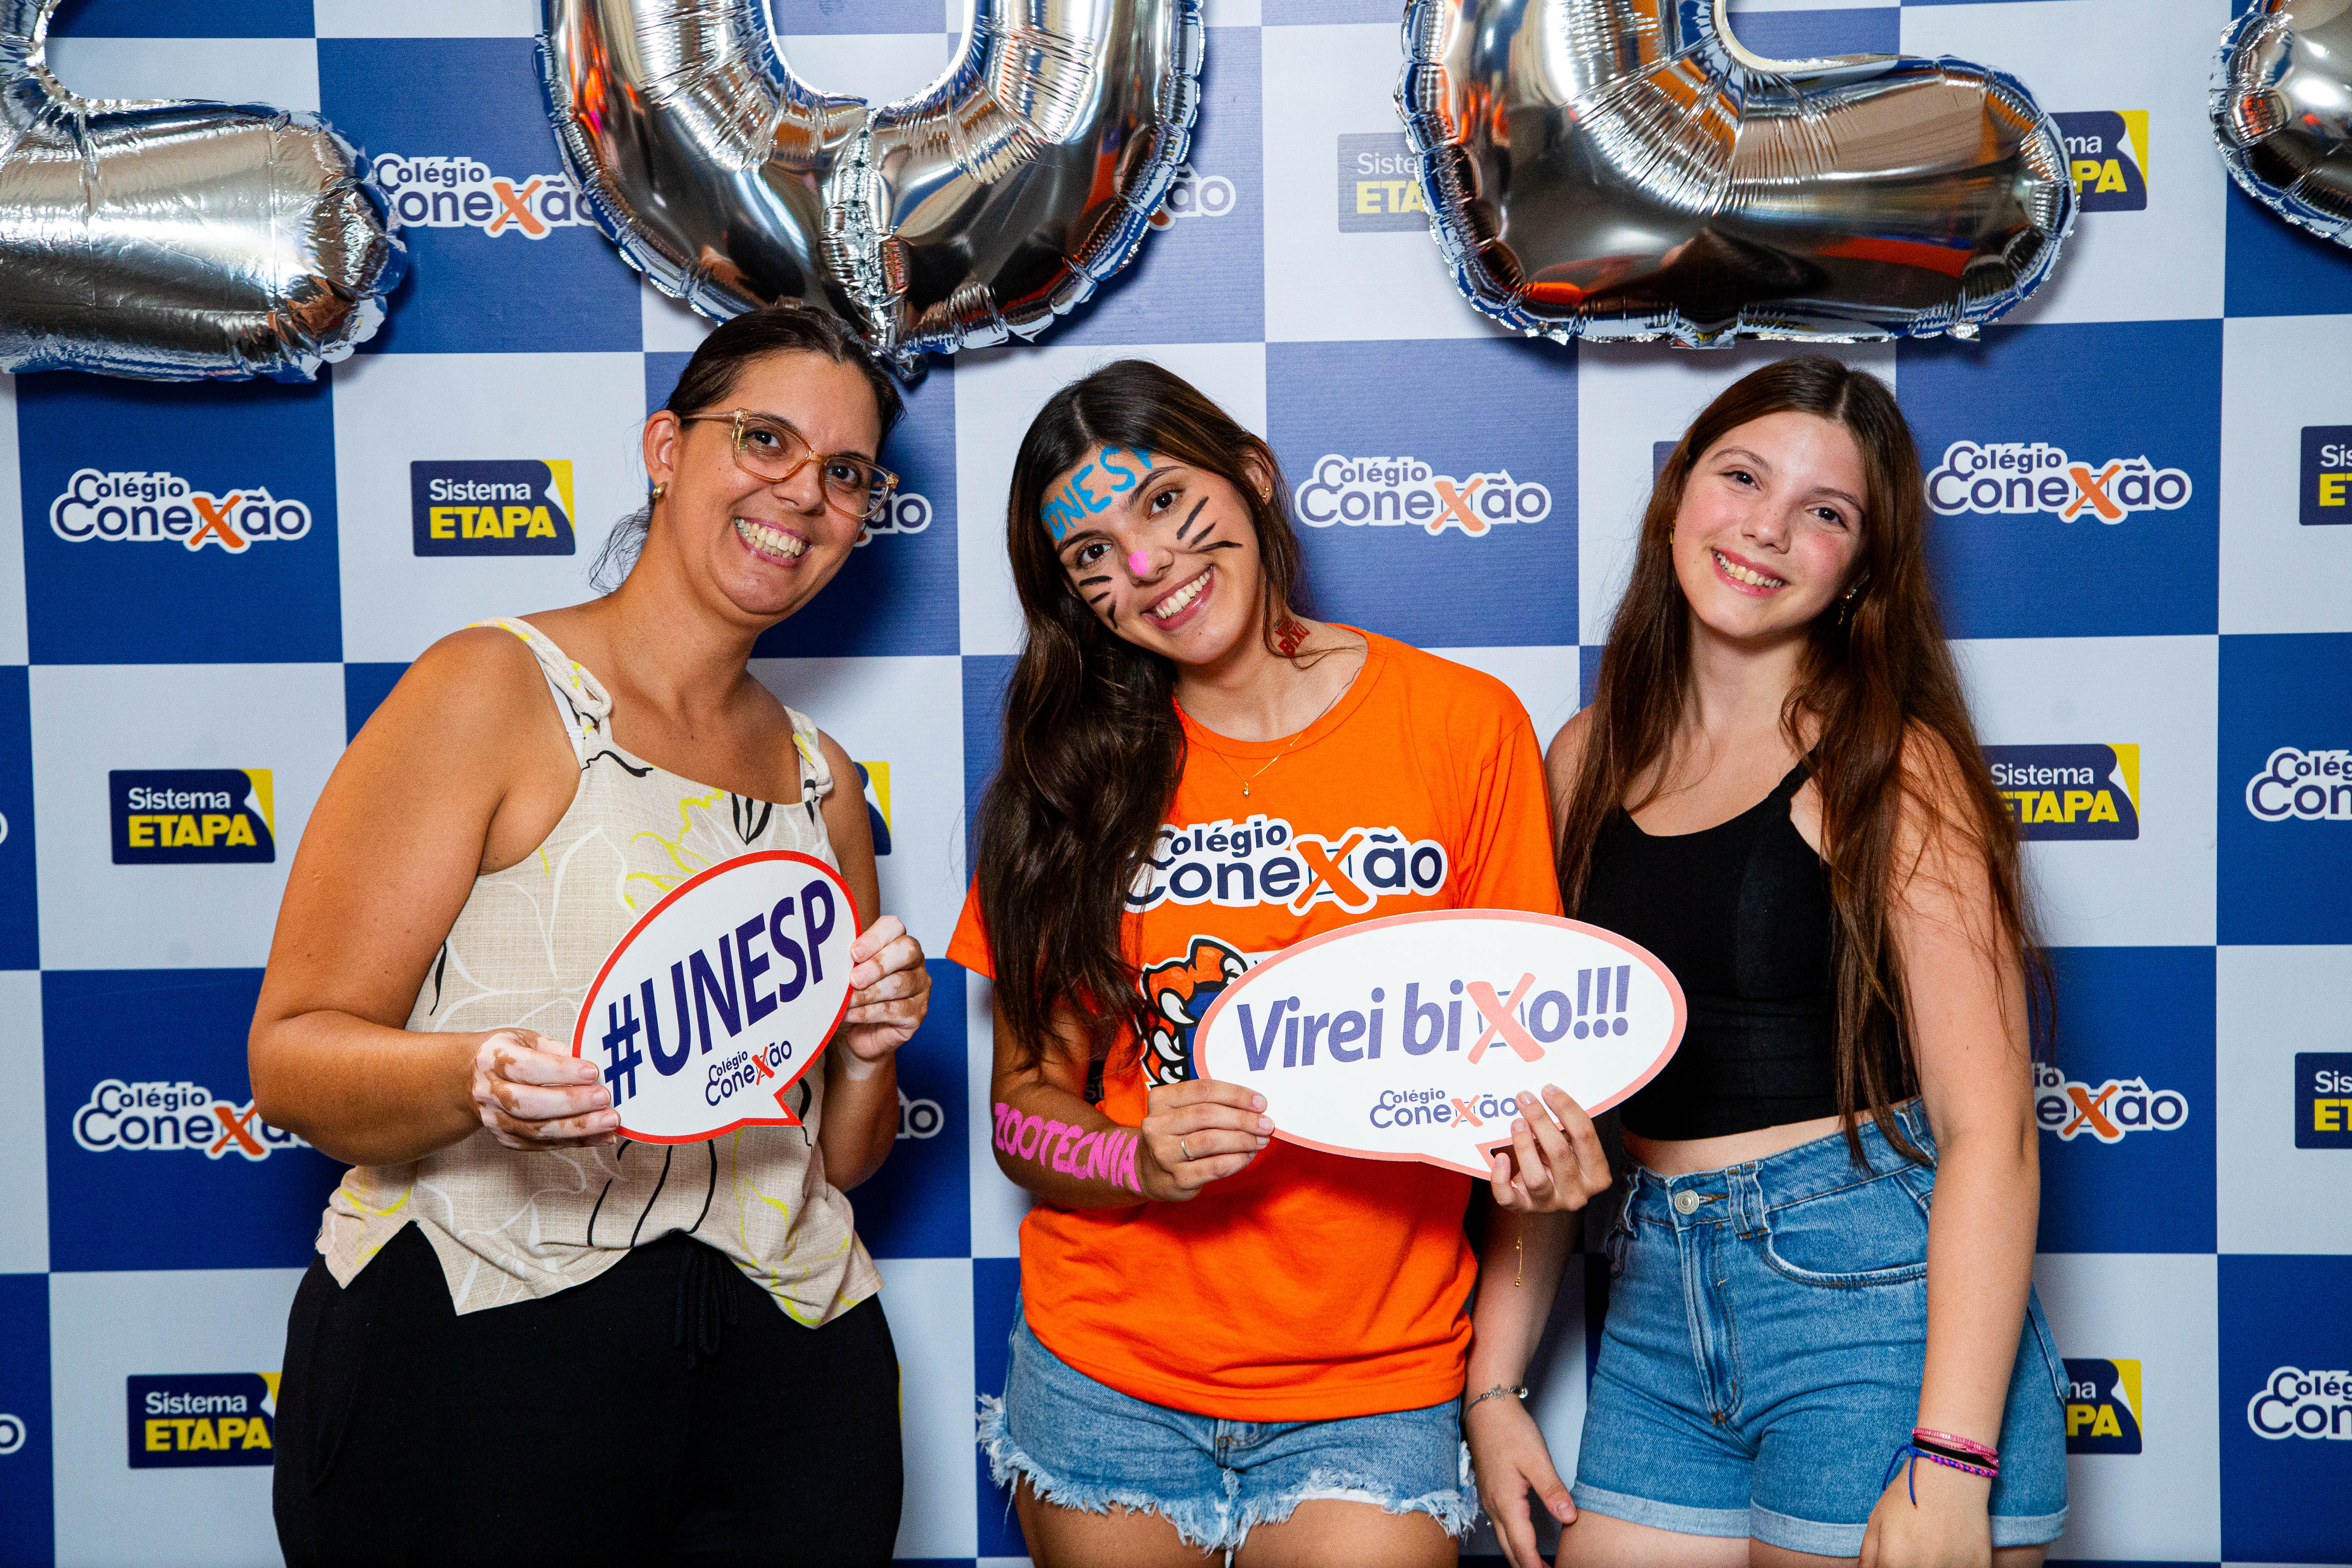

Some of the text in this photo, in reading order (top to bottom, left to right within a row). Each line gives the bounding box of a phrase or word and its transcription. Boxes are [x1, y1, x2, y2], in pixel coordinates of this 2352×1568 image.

[376, 159, 484, 191] Colégio
[1357, 153, 1417, 175] Siste
[1357, 180, 1426, 213] ETA
[1319, 459, 1427, 491] Colégio
[1949, 446, 2062, 475] Colégio
[74, 474, 184, 505] Colégio
[429, 478, 531, 501] Sistema
[429, 506, 557, 539] ETAPA
[1991, 763, 2094, 785] Sistema
[129, 787, 231, 810] Sistema
[129, 814, 257, 847] ETAPA
[602, 879, 835, 1108] #UNESP
[1237, 987, 1384, 1072] Virei
[708, 1051, 748, 1086] Colégio
[98, 1085, 205, 1116] Colégio
[1380, 1088, 1446, 1111] Colégio
[995, 1102, 1142, 1192] ZOOTECNIA
[145, 1391, 248, 1415] Sistema
[145, 1417, 273, 1452] ETAPA
